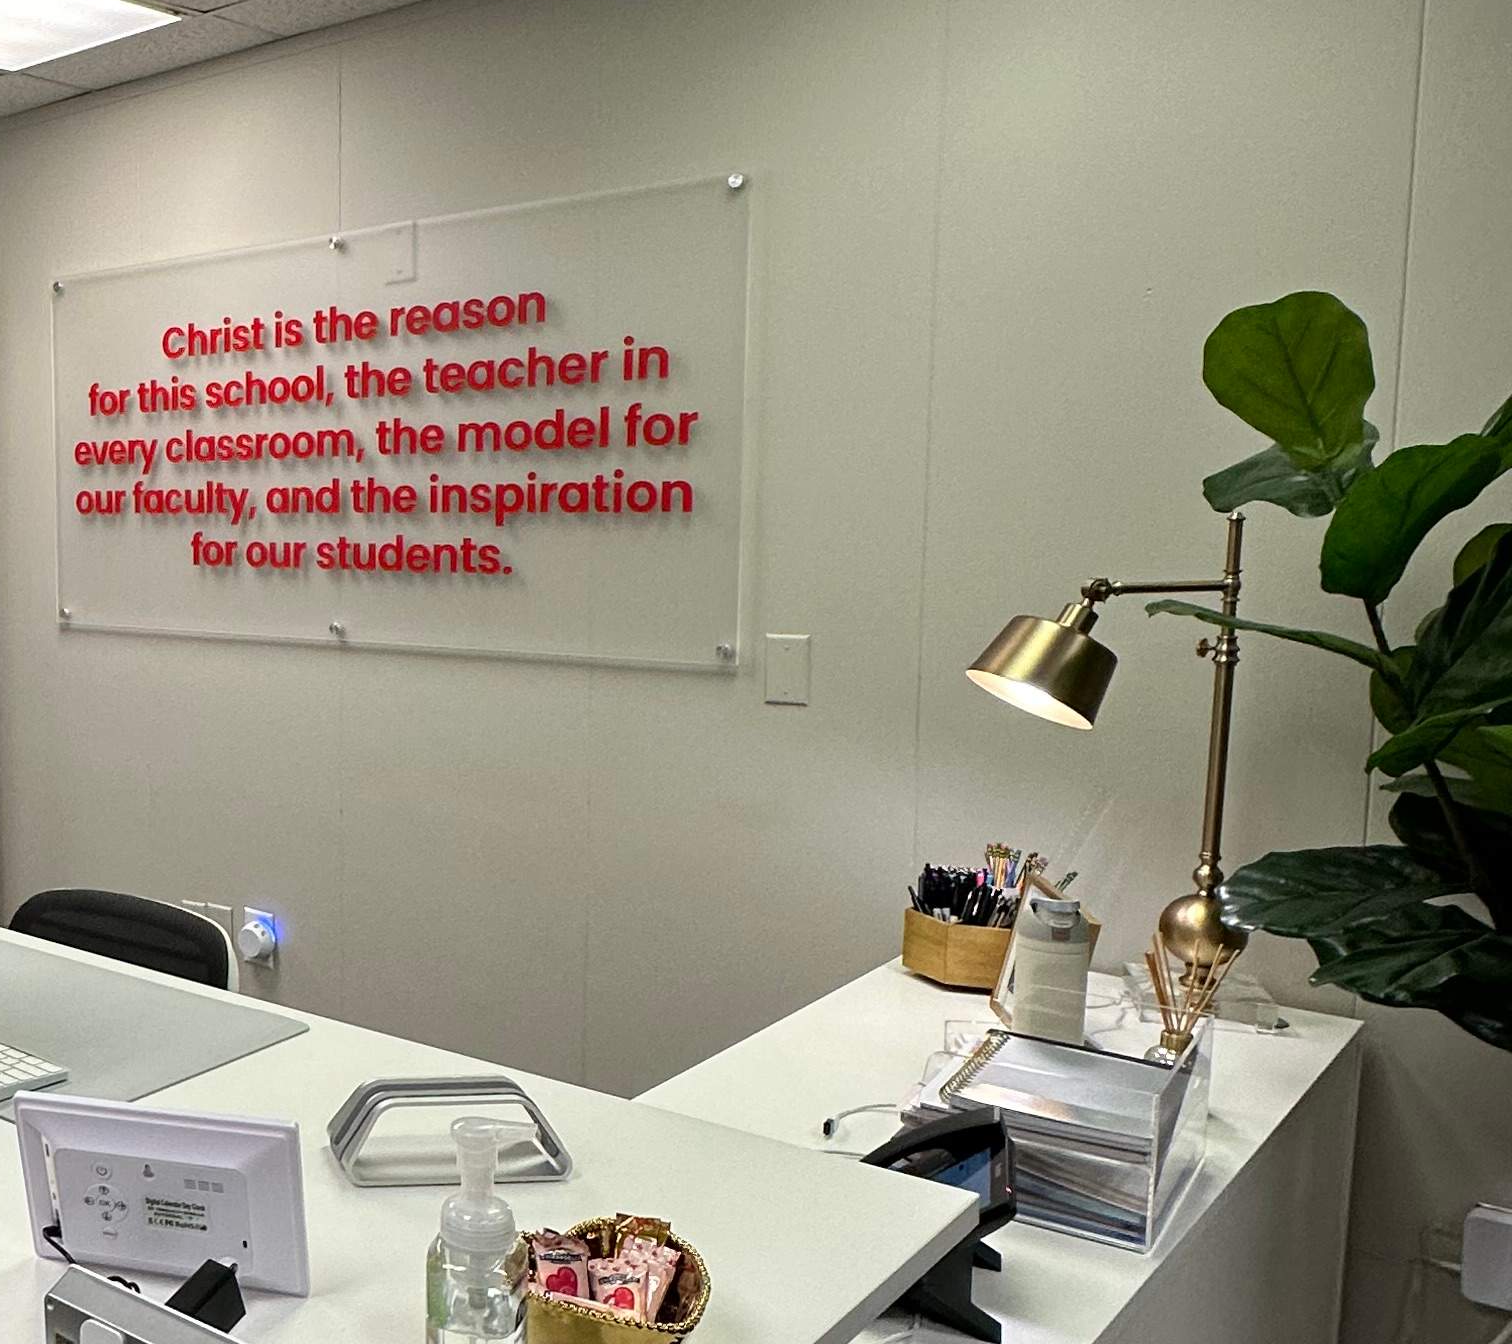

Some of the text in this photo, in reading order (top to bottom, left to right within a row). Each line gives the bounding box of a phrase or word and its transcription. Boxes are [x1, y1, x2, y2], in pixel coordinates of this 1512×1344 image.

[161, 291, 547, 360] Christ is the reason
[88, 336, 669, 417] for this school, the teacher in
[73, 402, 700, 476] every classroom, the model for
[75, 469, 694, 528] our faculty, and the inspiration
[190, 531, 513, 575] for our students.
